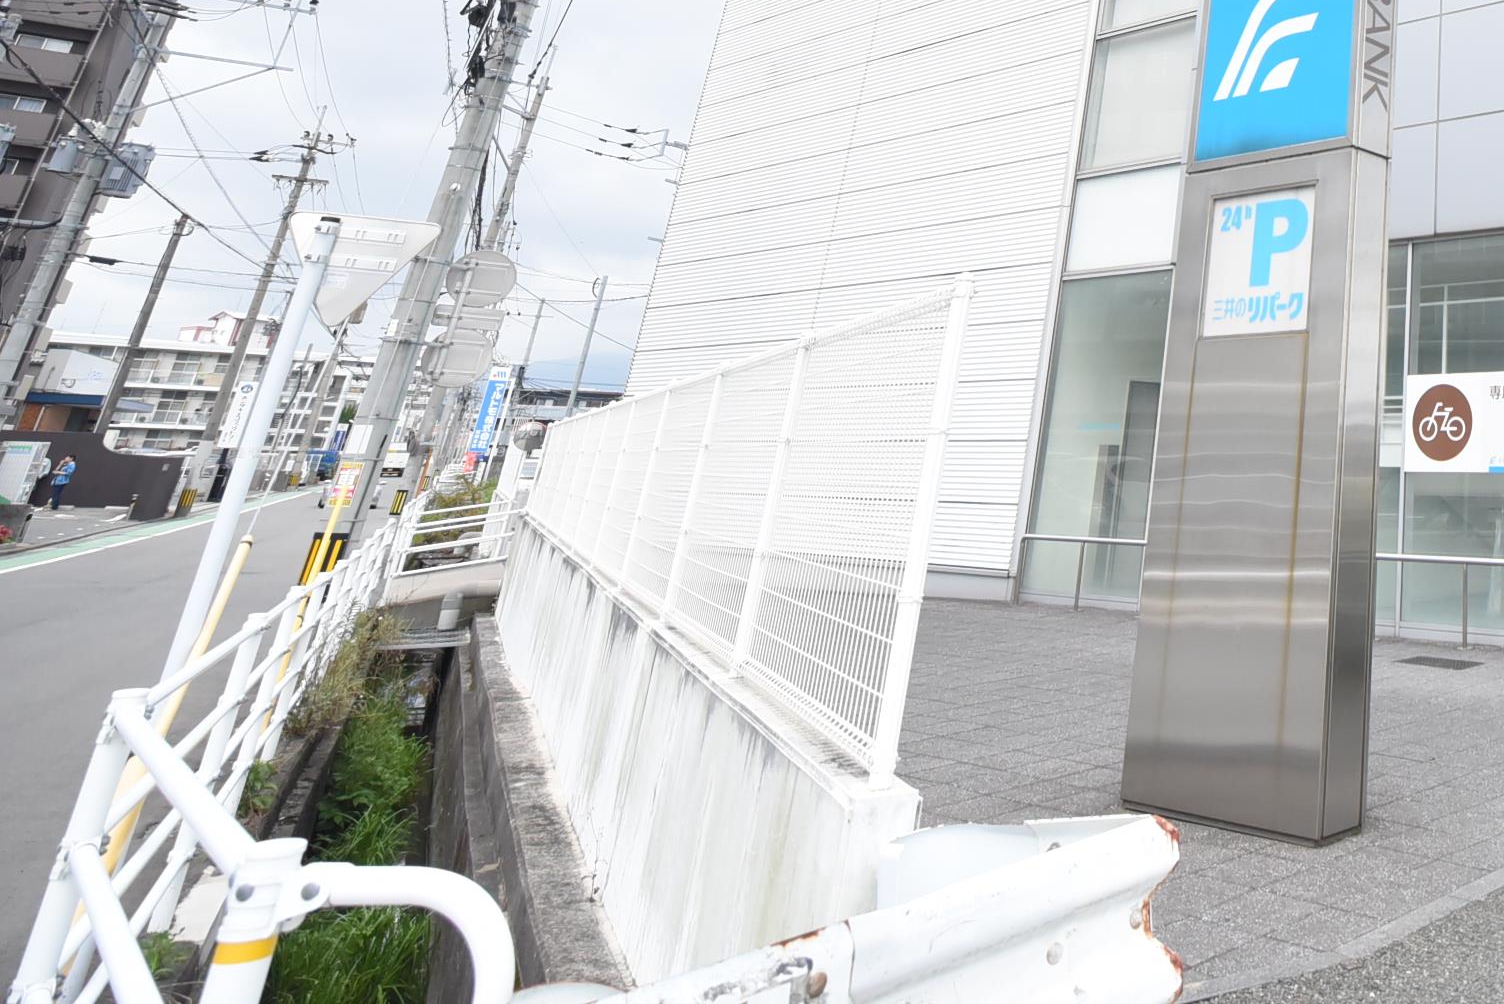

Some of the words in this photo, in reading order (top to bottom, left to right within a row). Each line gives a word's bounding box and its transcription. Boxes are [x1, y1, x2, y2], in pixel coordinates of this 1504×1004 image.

[1249, 198, 1309, 287] P
[1212, 292, 1304, 323] 三井のリパーク
